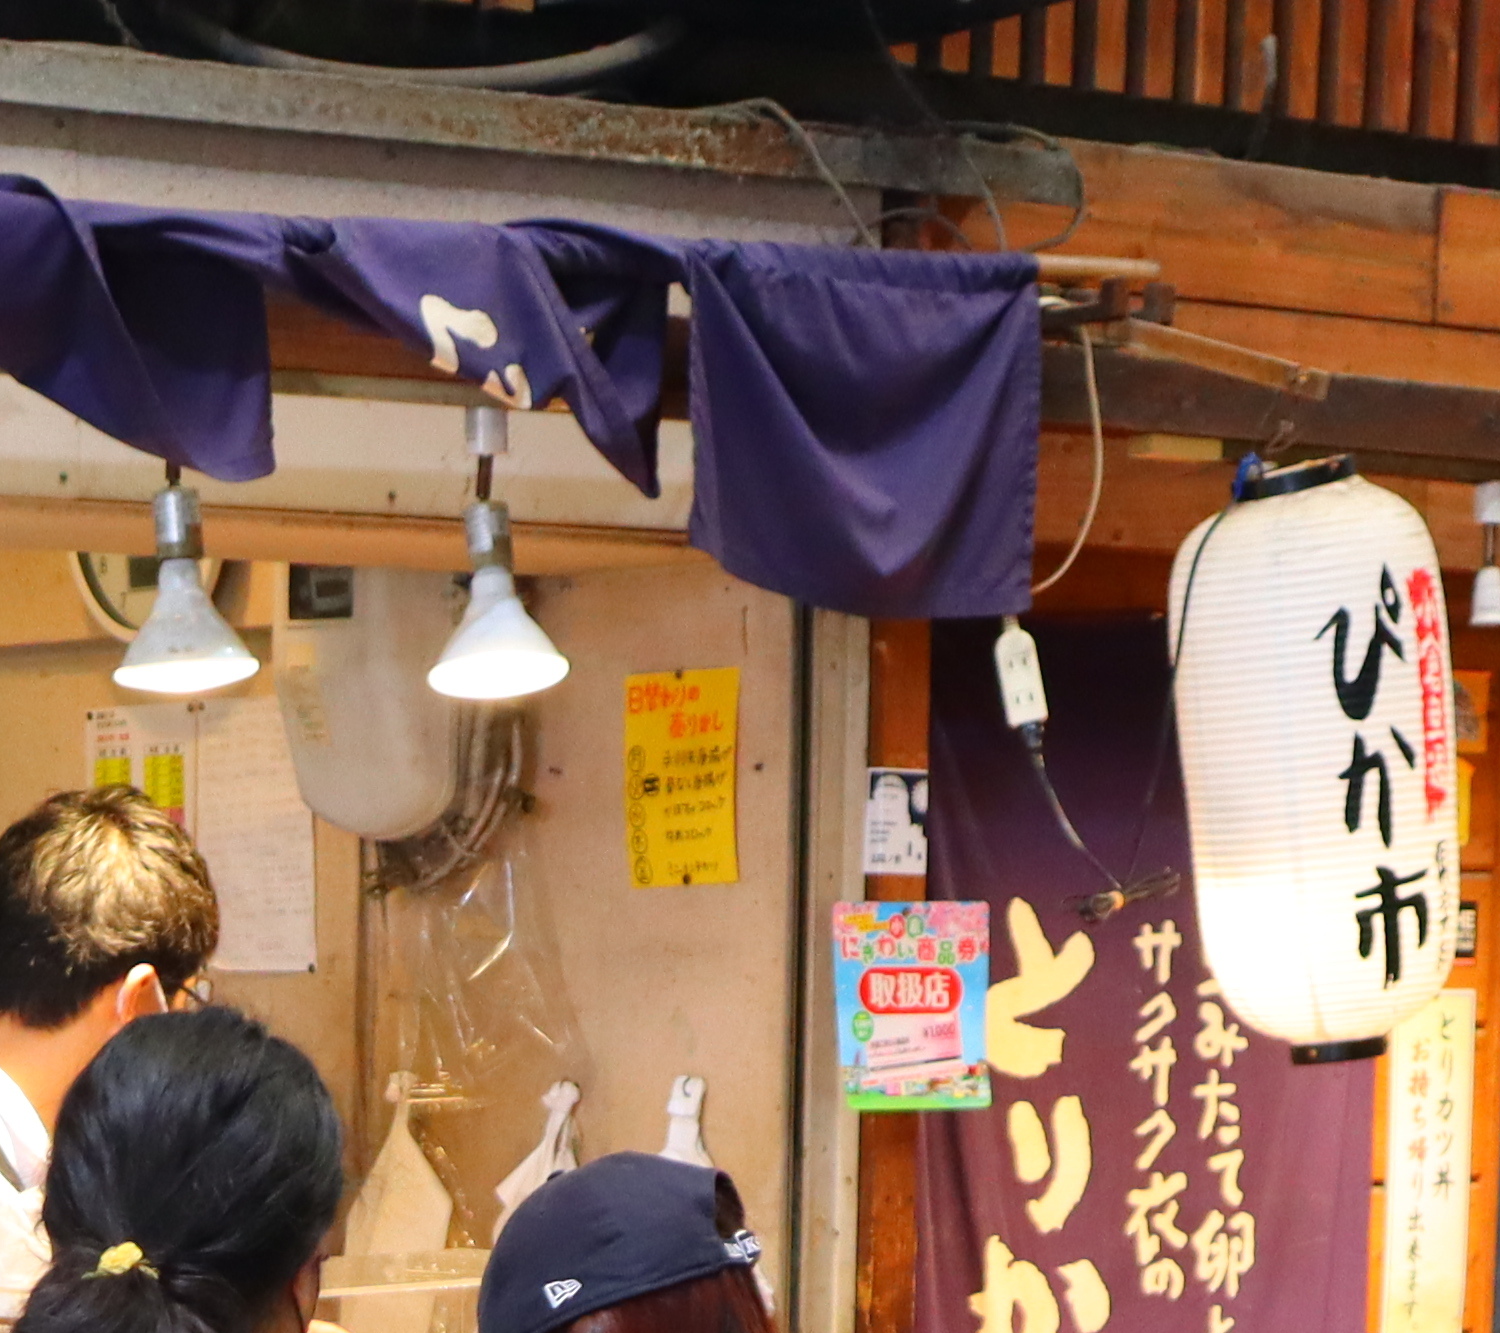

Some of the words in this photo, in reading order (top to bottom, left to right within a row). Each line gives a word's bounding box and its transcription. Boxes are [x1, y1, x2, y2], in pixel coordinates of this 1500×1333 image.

[1314, 562, 1428, 990] ぴか市
[869, 973, 950, 1009] 取扱店
[1124, 918, 1188, 1301] サクサク衣の
